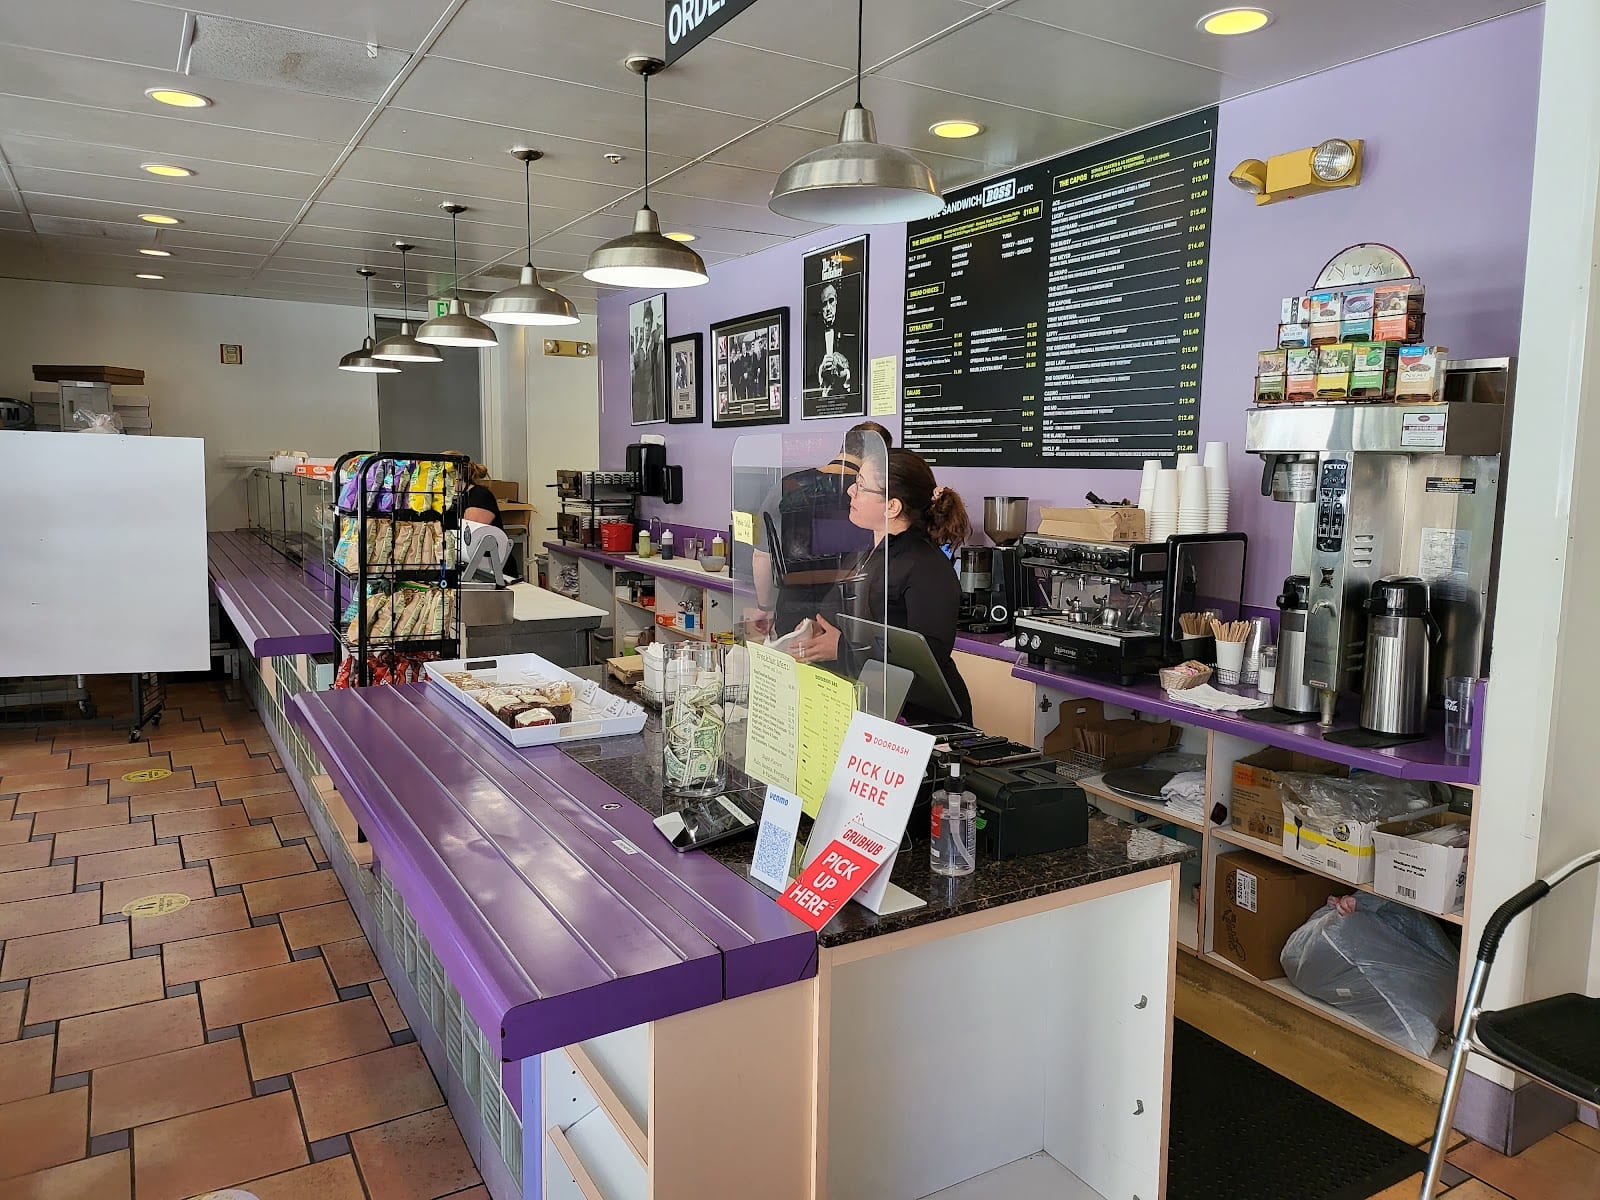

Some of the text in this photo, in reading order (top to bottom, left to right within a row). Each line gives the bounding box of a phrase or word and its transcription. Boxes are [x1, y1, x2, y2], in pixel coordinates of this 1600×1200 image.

[668, 0, 725, 44] ORD
[1058, 172, 1087, 188] THE CAPOS
[942, 194, 982, 216] SANDWICH
[986, 183, 1012, 202] BOSS
[1051, 211, 1064, 220] LUCKY
[906, 388, 920, 396] SALADS
[873, 737, 910, 756] DOORDASH
[847, 755, 905, 788] PICK UP
[769, 792, 789, 806] venmo
[850, 778, 888, 807] HERE
[842, 829, 884, 856] GRUBHUB
[821, 851, 861, 881] PICK
[813, 872, 837, 891] UP
[788, 884, 829, 917] HERE
